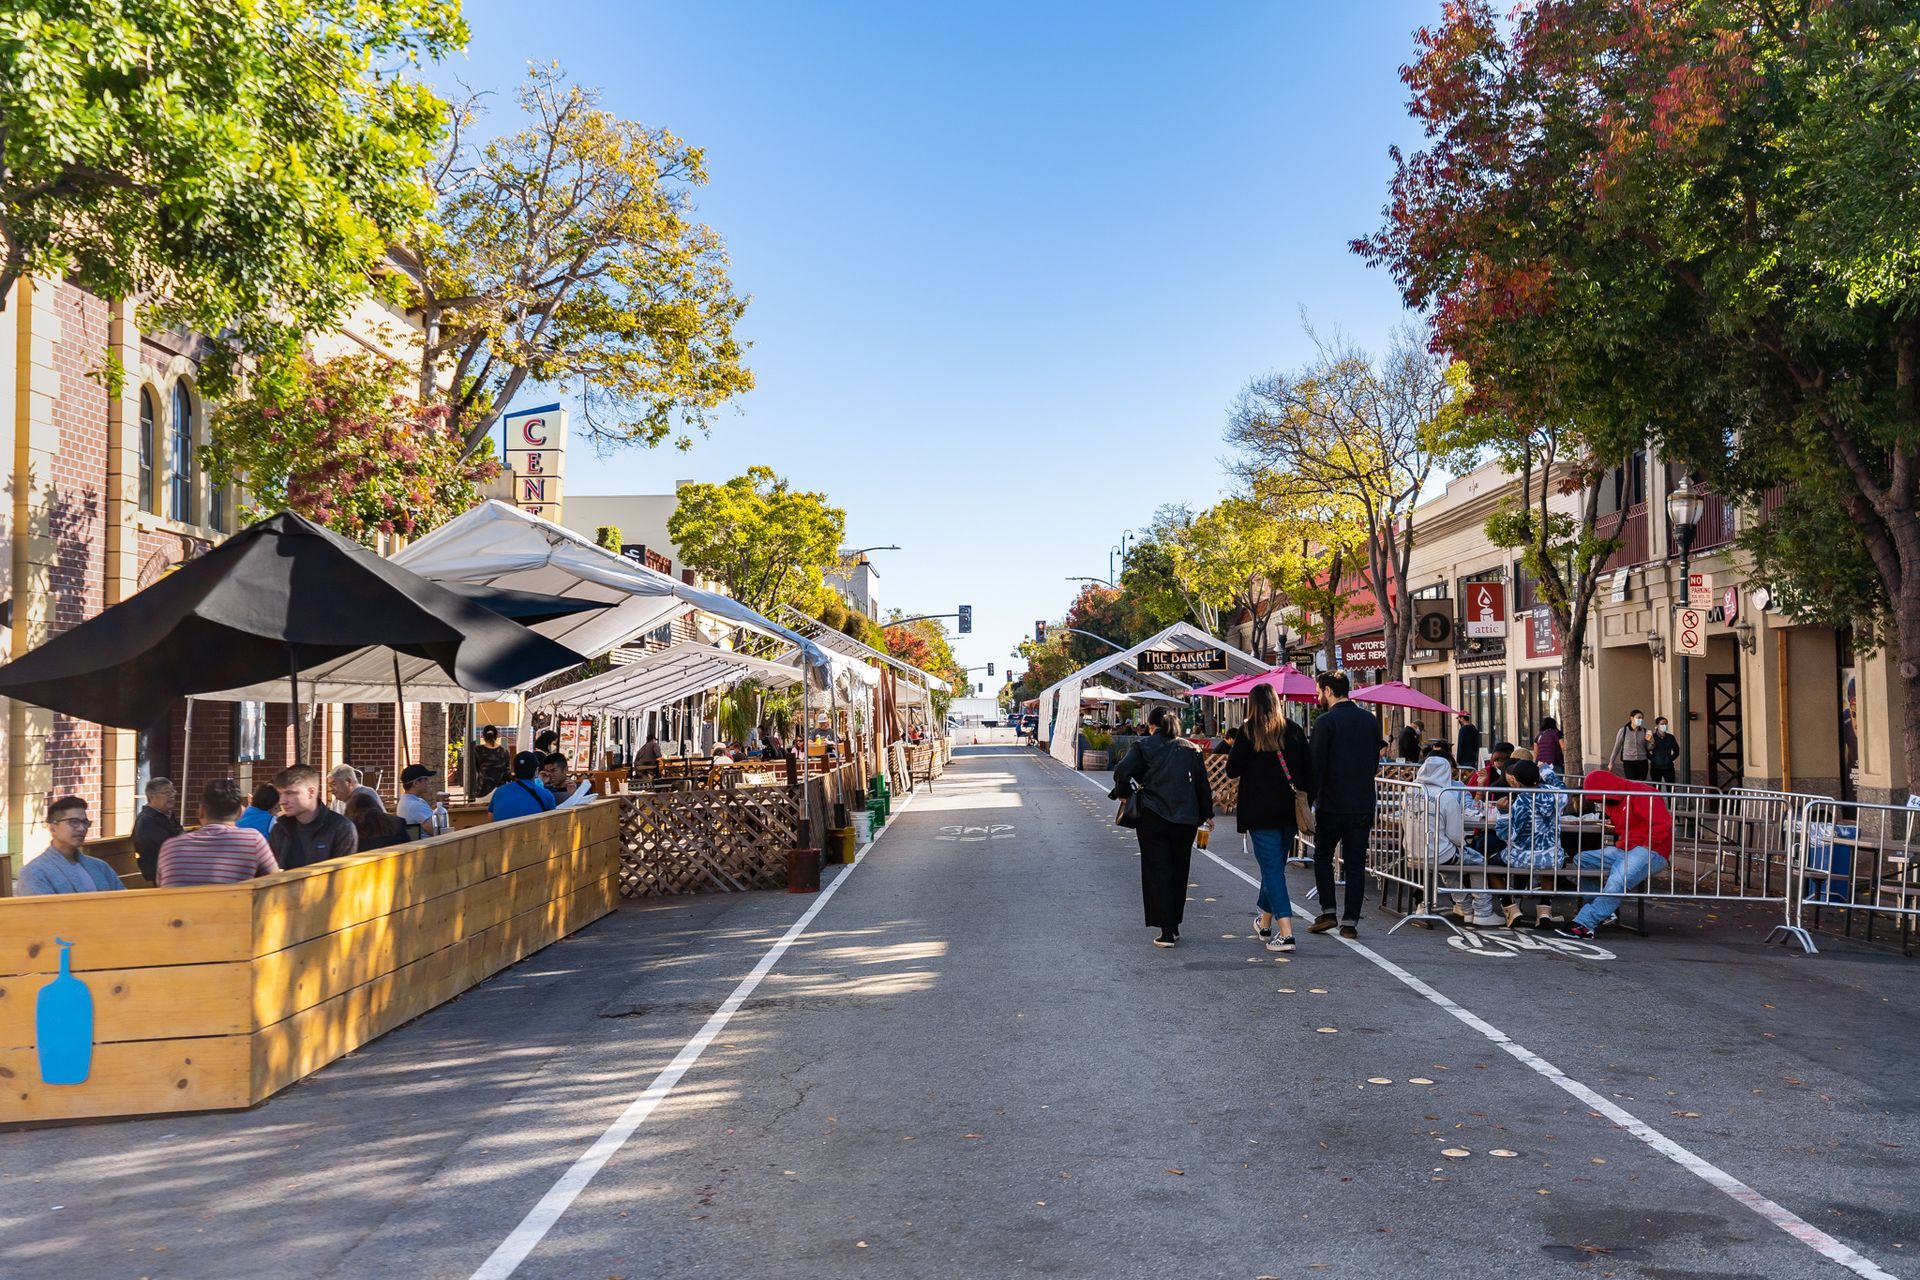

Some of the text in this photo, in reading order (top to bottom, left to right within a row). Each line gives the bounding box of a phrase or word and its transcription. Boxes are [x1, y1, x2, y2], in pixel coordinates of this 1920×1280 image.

[1690, 576, 1702, 585] NO
[1428, 617, 1442, 638] B
[1475, 624, 1498, 634] attic
[1352, 641, 1385, 650] VICTOR'S
[1145, 649, 1220, 663] THE BARREL
[1346, 652, 1366, 661] SHOE
